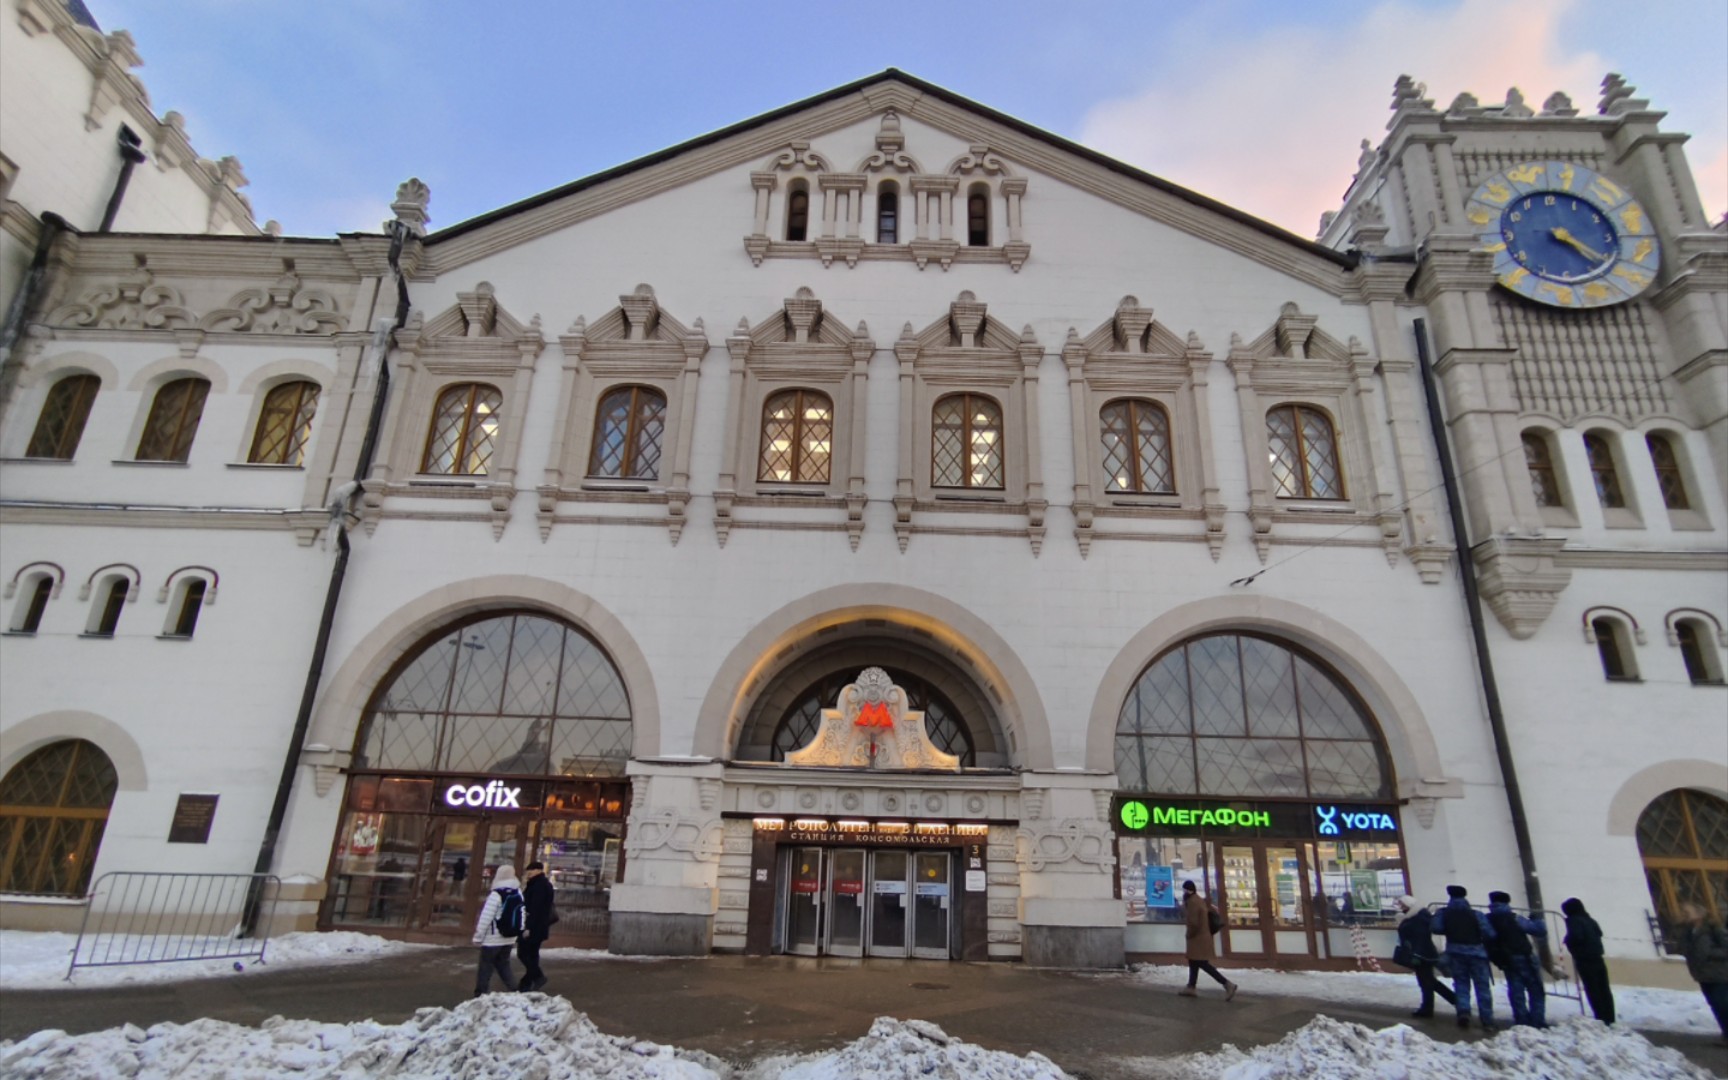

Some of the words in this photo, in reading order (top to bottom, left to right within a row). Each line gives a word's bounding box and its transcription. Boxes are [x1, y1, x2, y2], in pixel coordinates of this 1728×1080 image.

[1544, 195, 1556, 206] 12
[1572, 201, 1577, 211] 1
[1510, 211, 1521, 222] 10
[446, 780, 521, 808] cofix
[1341, 813, 1395, 829] YOTA
[791, 833, 844, 841] СТАНЦИЯ
[856, 835, 950, 844] КОМСОМОЛЬСКАЯ
